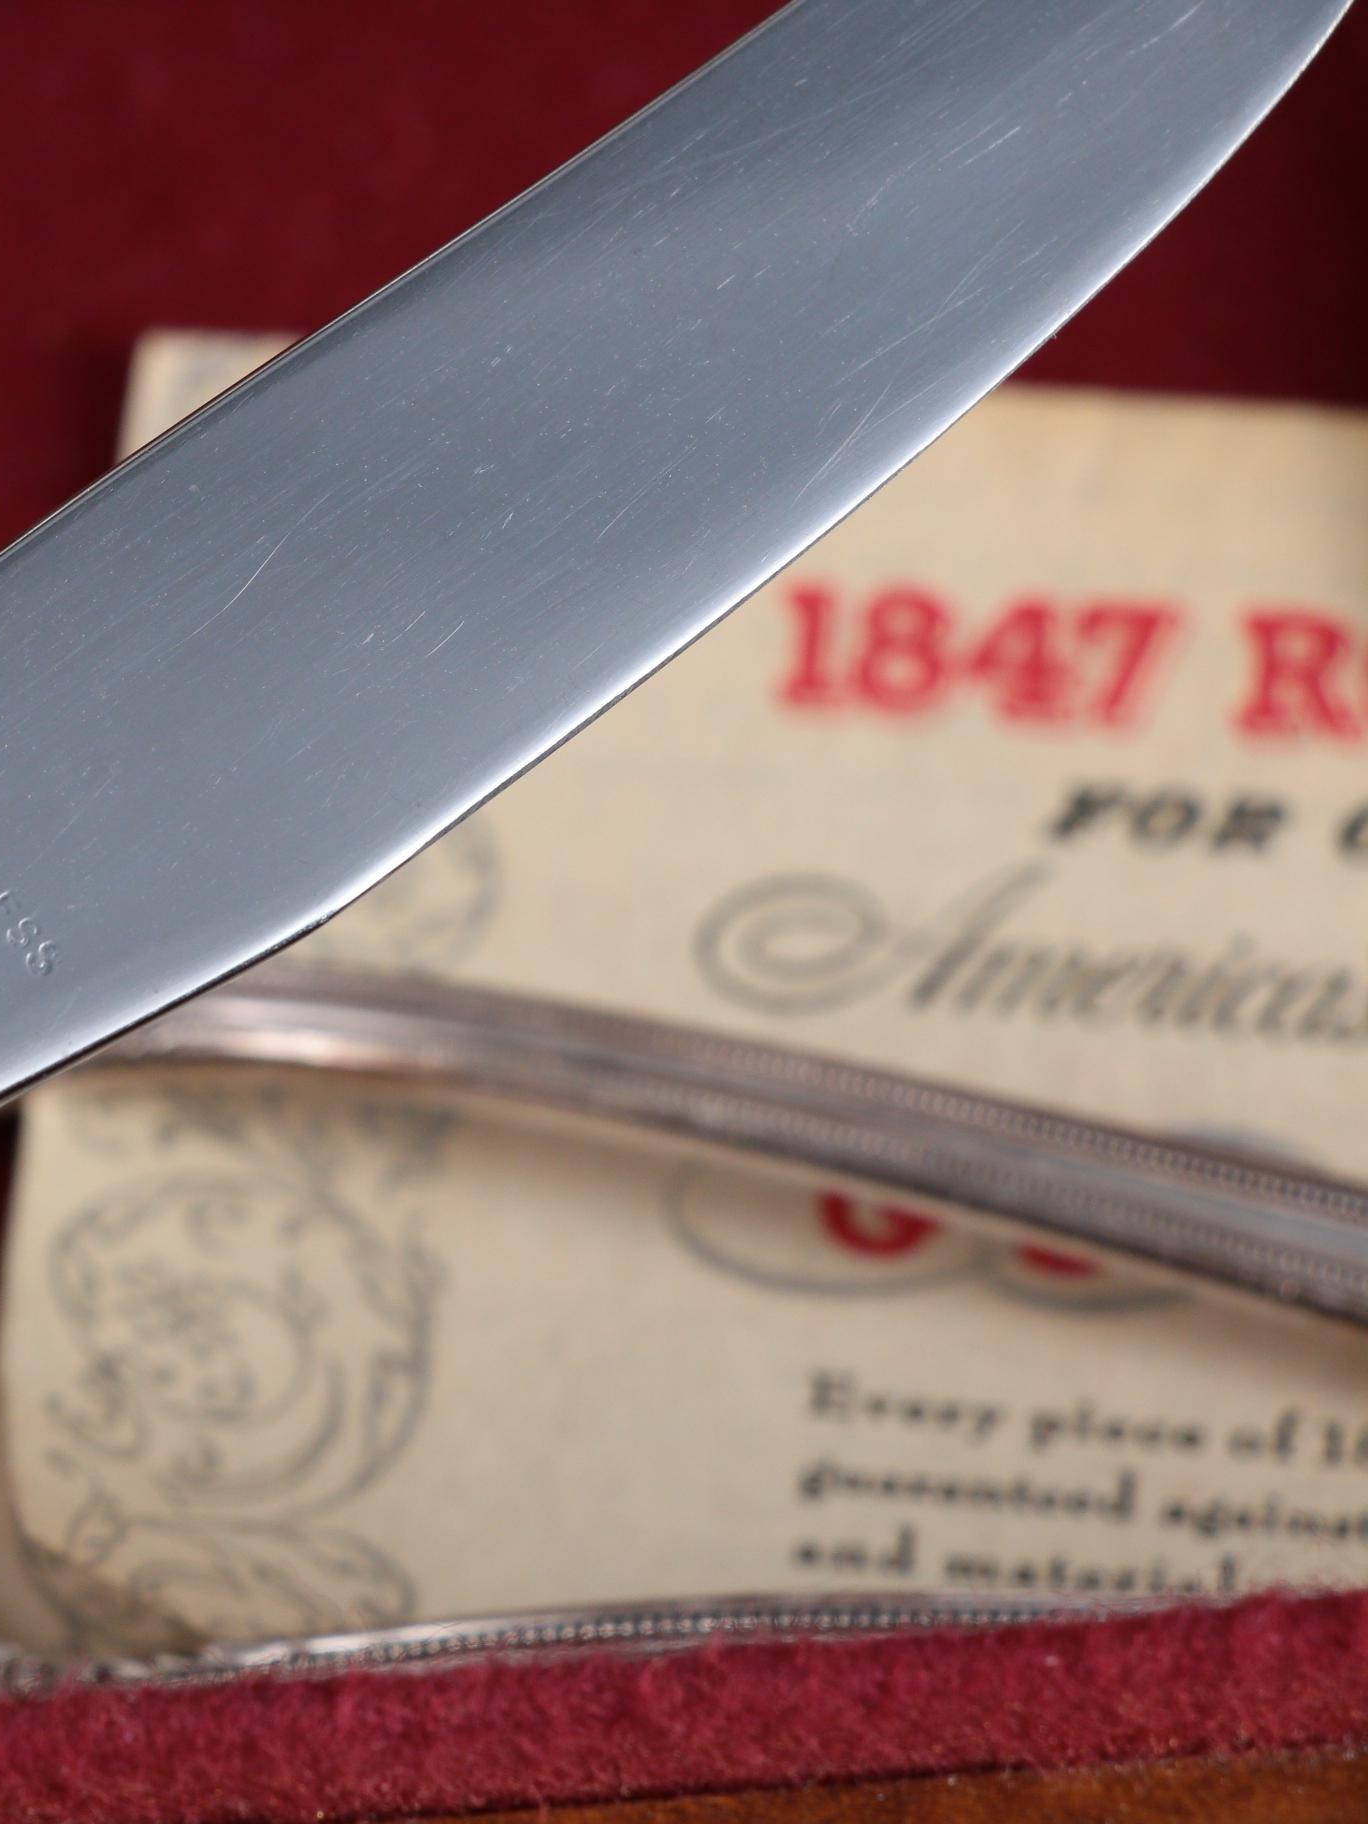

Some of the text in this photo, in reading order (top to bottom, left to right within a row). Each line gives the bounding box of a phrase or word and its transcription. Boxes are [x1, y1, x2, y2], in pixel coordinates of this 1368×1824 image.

[780, 576, 1368, 746] 1847 R
[1047, 785, 1286, 854] FOR
[811, 1370, 1000, 1446] Every
[1230, 1408, 1301, 1460] of
[793, 1523, 916, 1576] and
